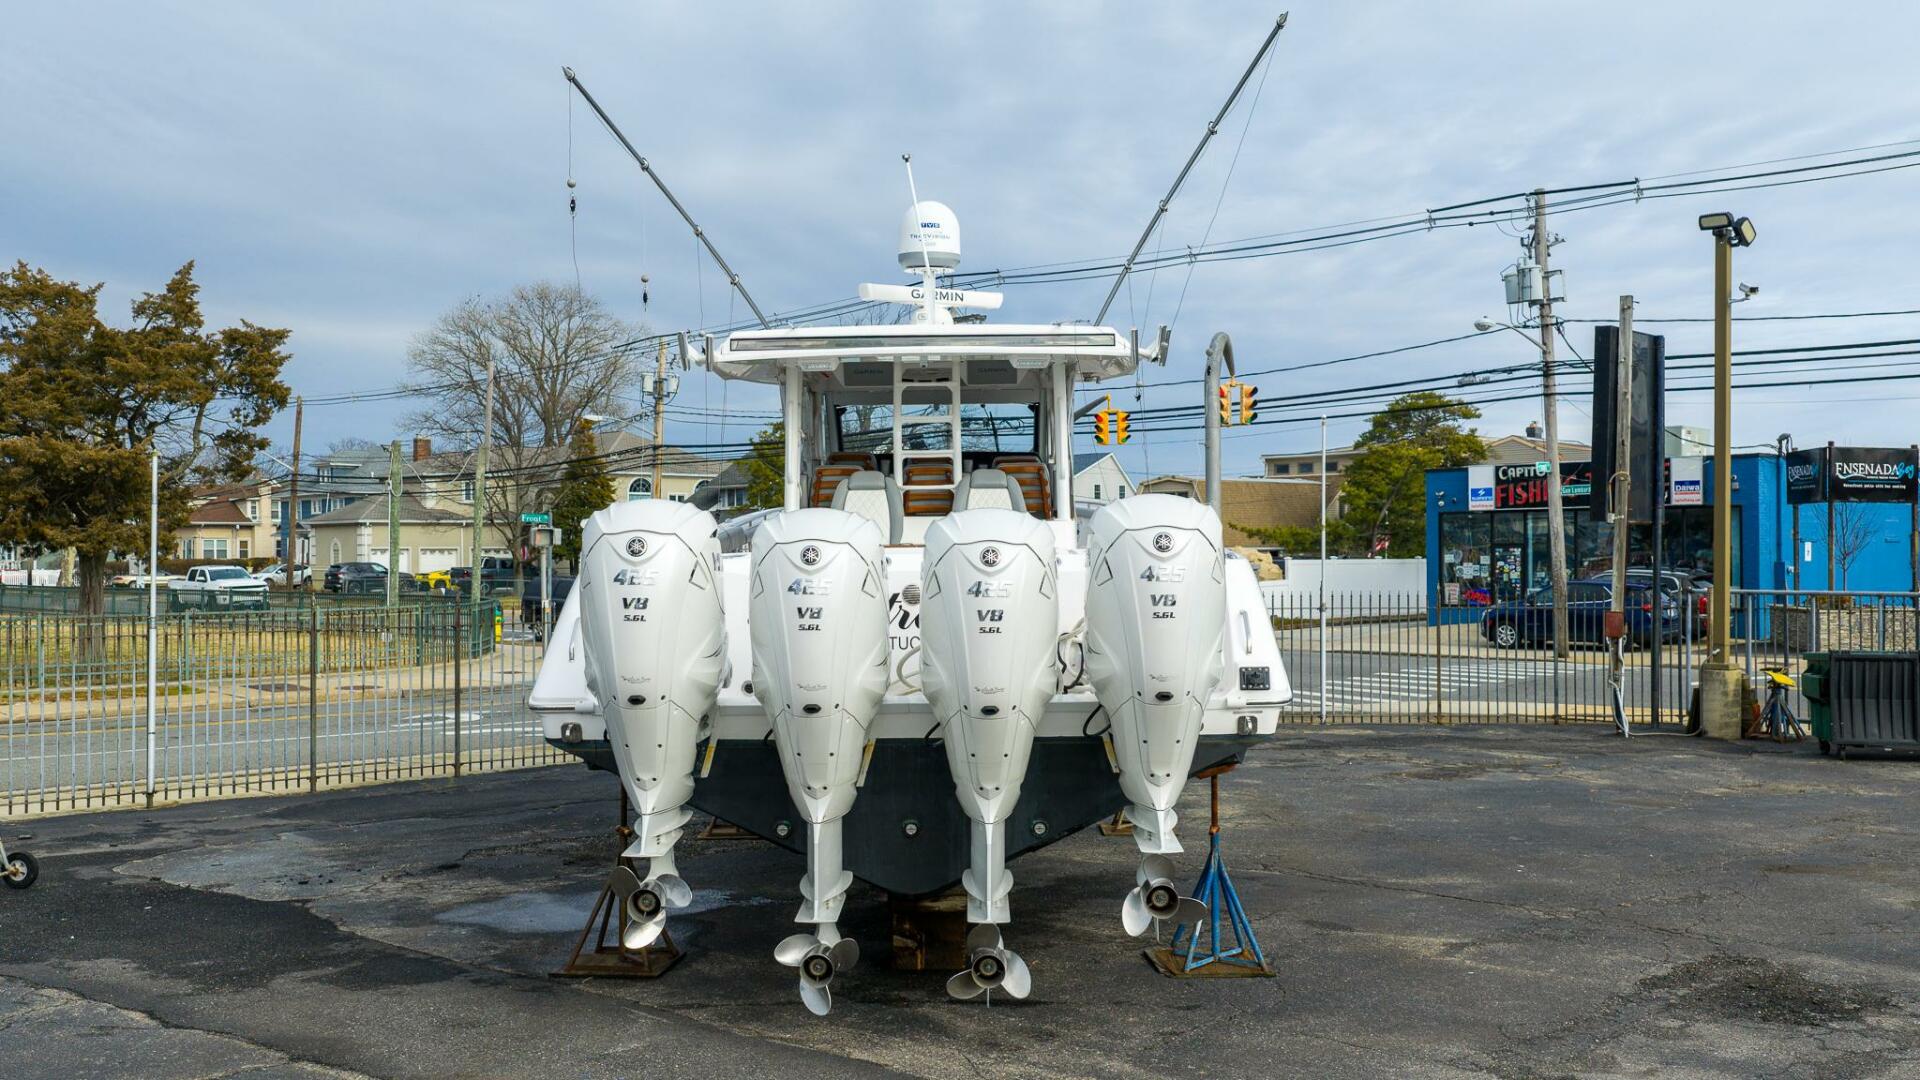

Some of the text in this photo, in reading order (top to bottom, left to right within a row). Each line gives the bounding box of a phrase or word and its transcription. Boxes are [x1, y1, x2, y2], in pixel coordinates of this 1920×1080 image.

[1498, 466, 1547, 480] CAPITO
[1834, 462, 1900, 479] ENSENADA
[1495, 480, 1549, 508] FISHI
[613, 569, 660, 586] 425
[1140, 565, 1187, 583] 425
[787, 578, 834, 595] 425
[967, 580, 1014, 598] 425
[622, 597, 649, 610] V8
[1150, 594, 1177, 607] V8
[624, 614, 647, 622] 5.6L
[797, 607, 823, 620] V8
[977, 609, 1004, 622] V8
[1152, 611, 1176, 619] 5.6L
[798, 623, 821, 631] 5.6L
[979, 626, 1002, 634] 5.6L
